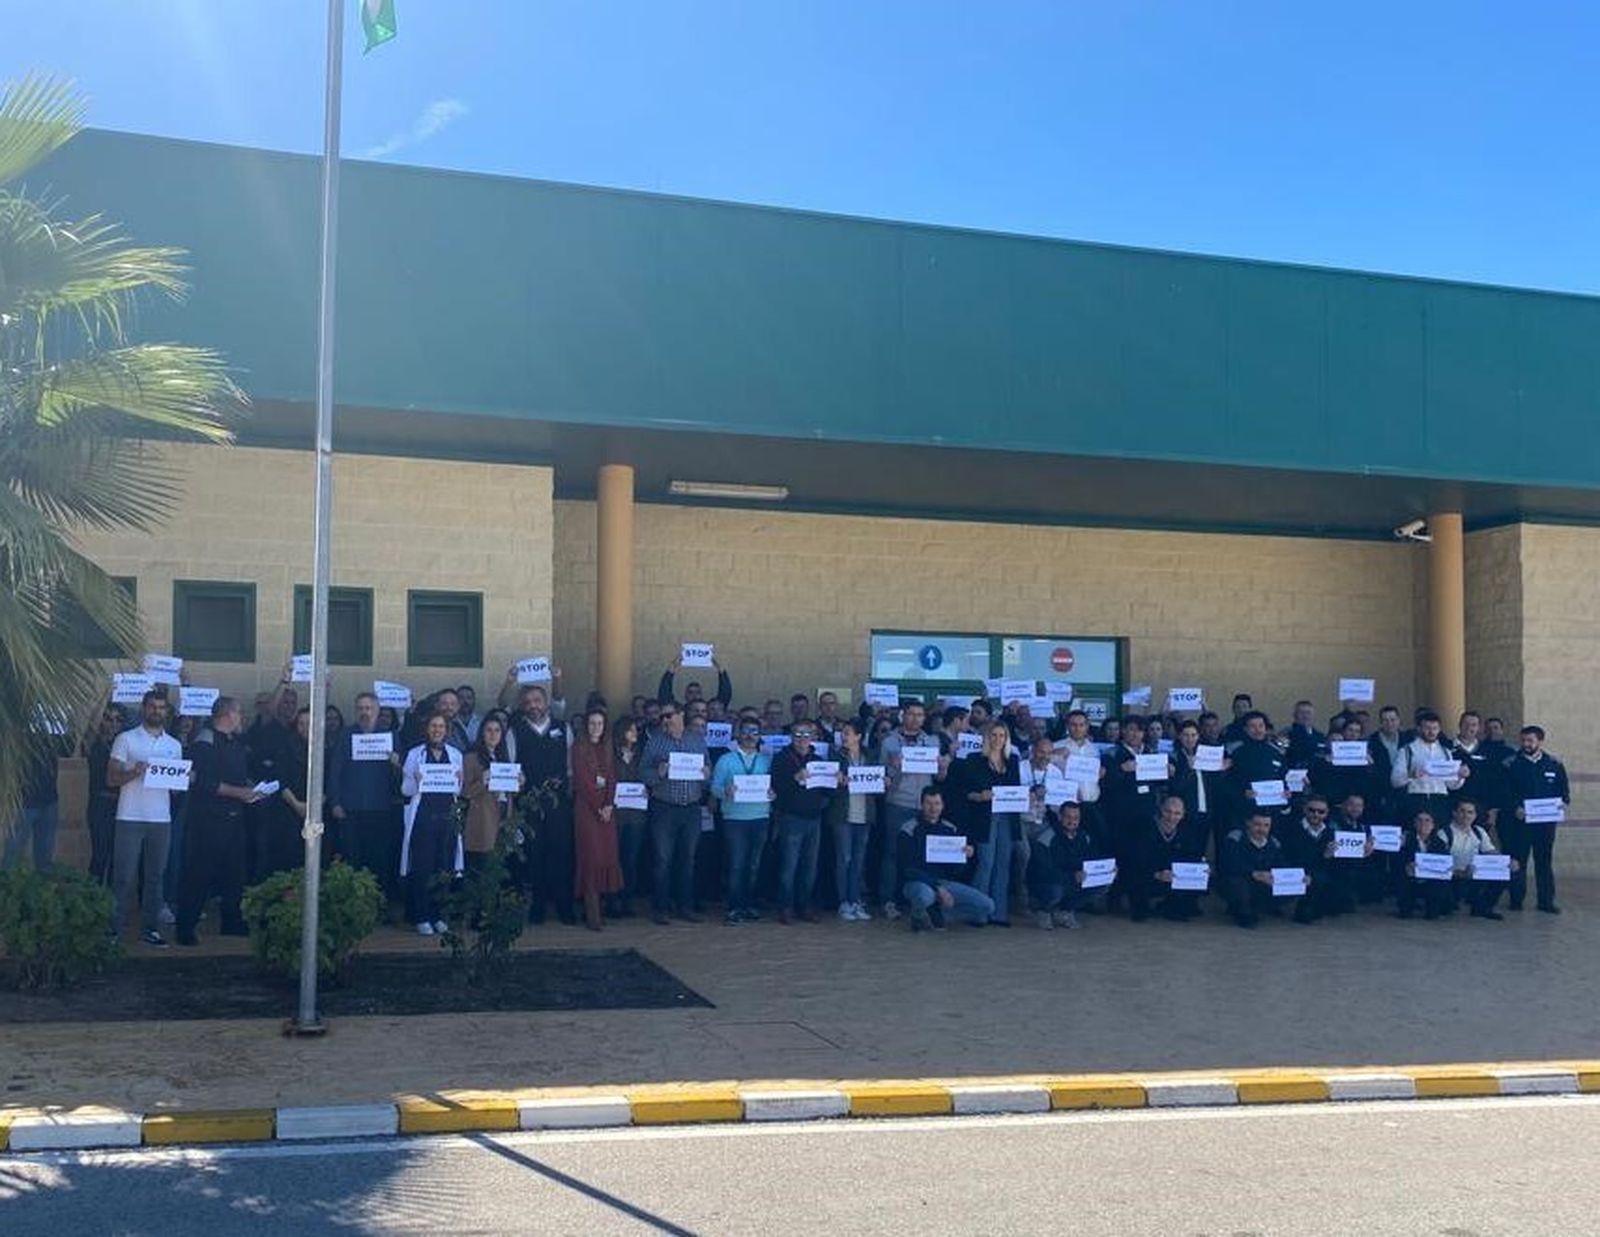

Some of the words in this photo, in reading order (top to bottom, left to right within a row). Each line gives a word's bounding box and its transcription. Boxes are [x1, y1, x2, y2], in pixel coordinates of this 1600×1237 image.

[685, 649, 710, 658] STOP
[1173, 693, 1198, 701] STOP
[708, 729, 729, 738] TOP
[962, 741, 982, 749] STO
[150, 765, 186, 776] STOP
[852, 773, 881, 782] STOP
[1339, 838, 1364, 847] STOP
